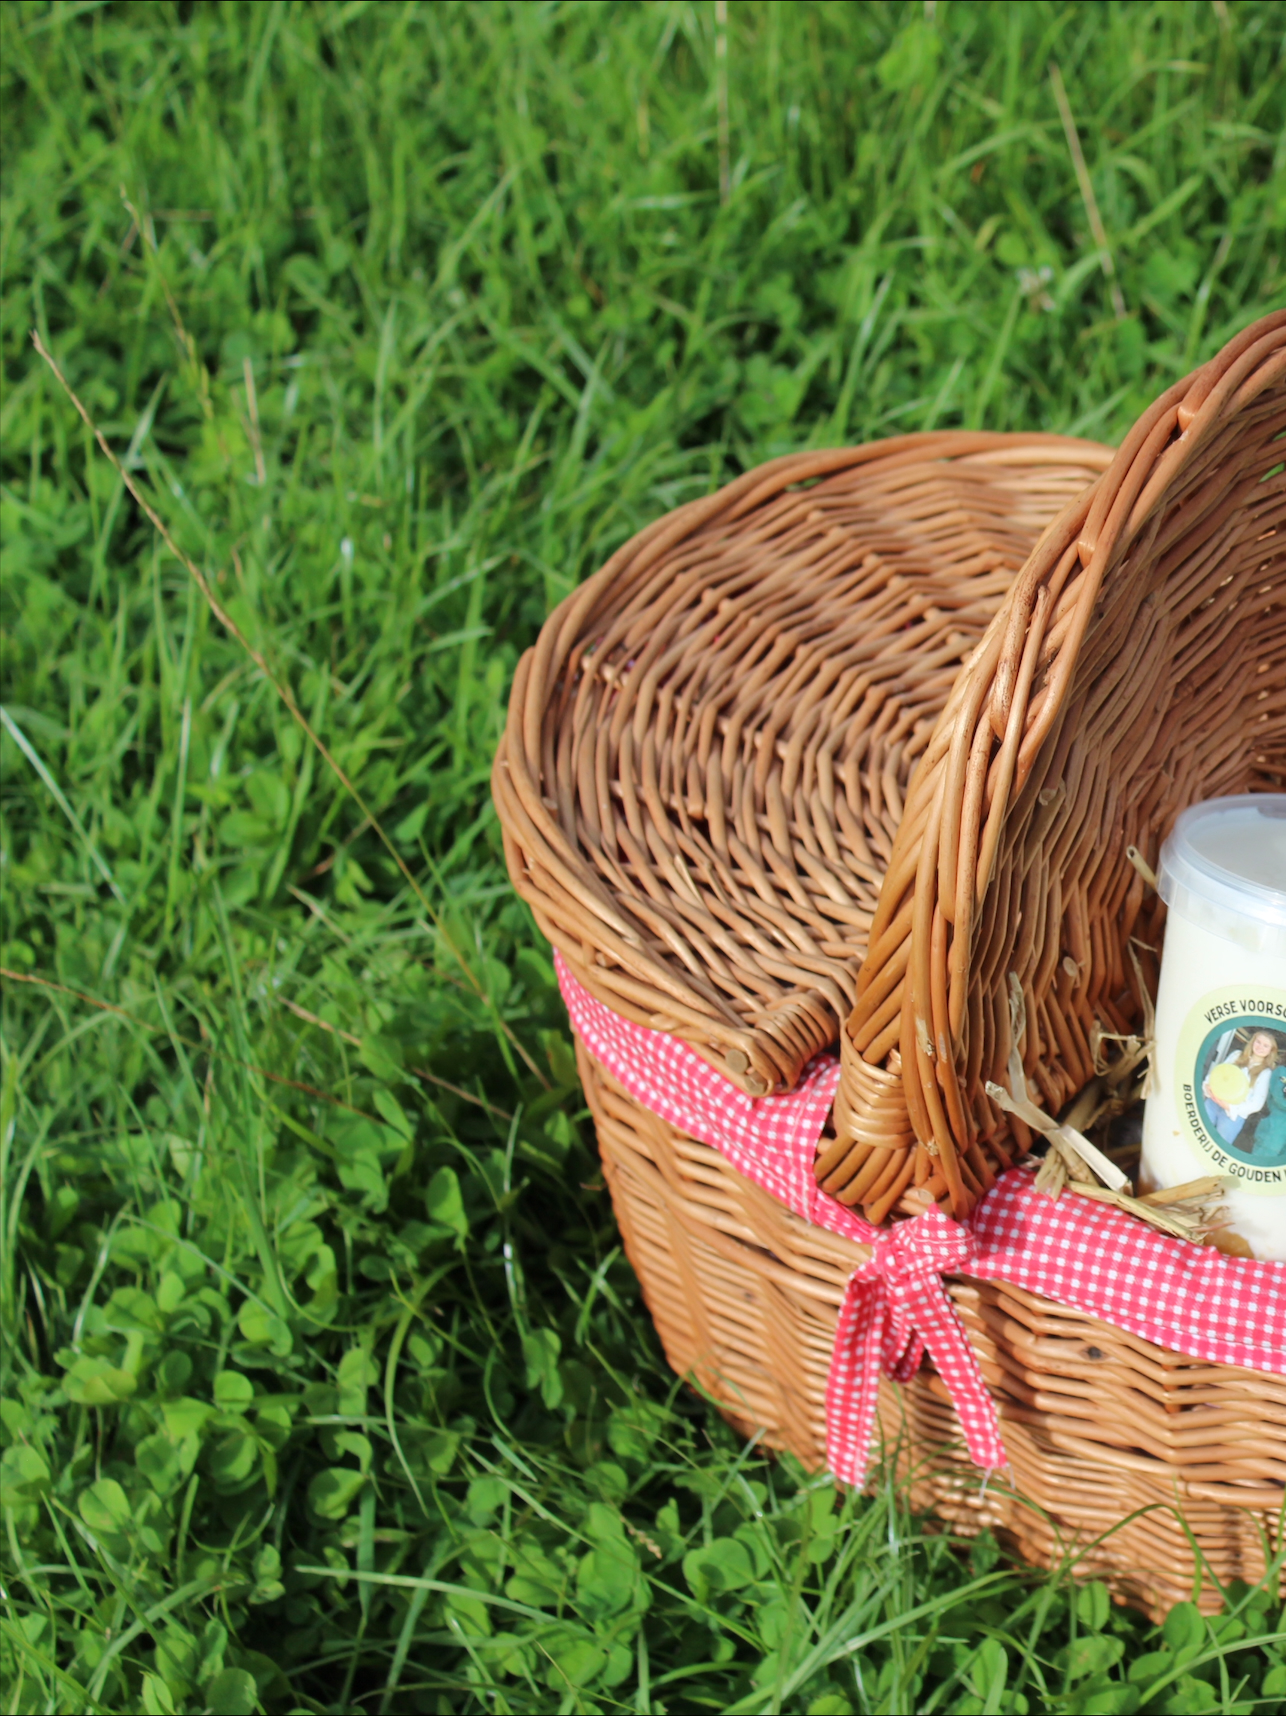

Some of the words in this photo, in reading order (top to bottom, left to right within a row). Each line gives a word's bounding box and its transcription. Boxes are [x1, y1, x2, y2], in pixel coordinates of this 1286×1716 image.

[1204, 1000, 1238, 1024] VERSE
[1182, 1083, 1214, 1153] BOERDERIJ
[1211, 1150, 1228, 1169] DE
[1228, 1164, 1282, 1184] GOUDEN
